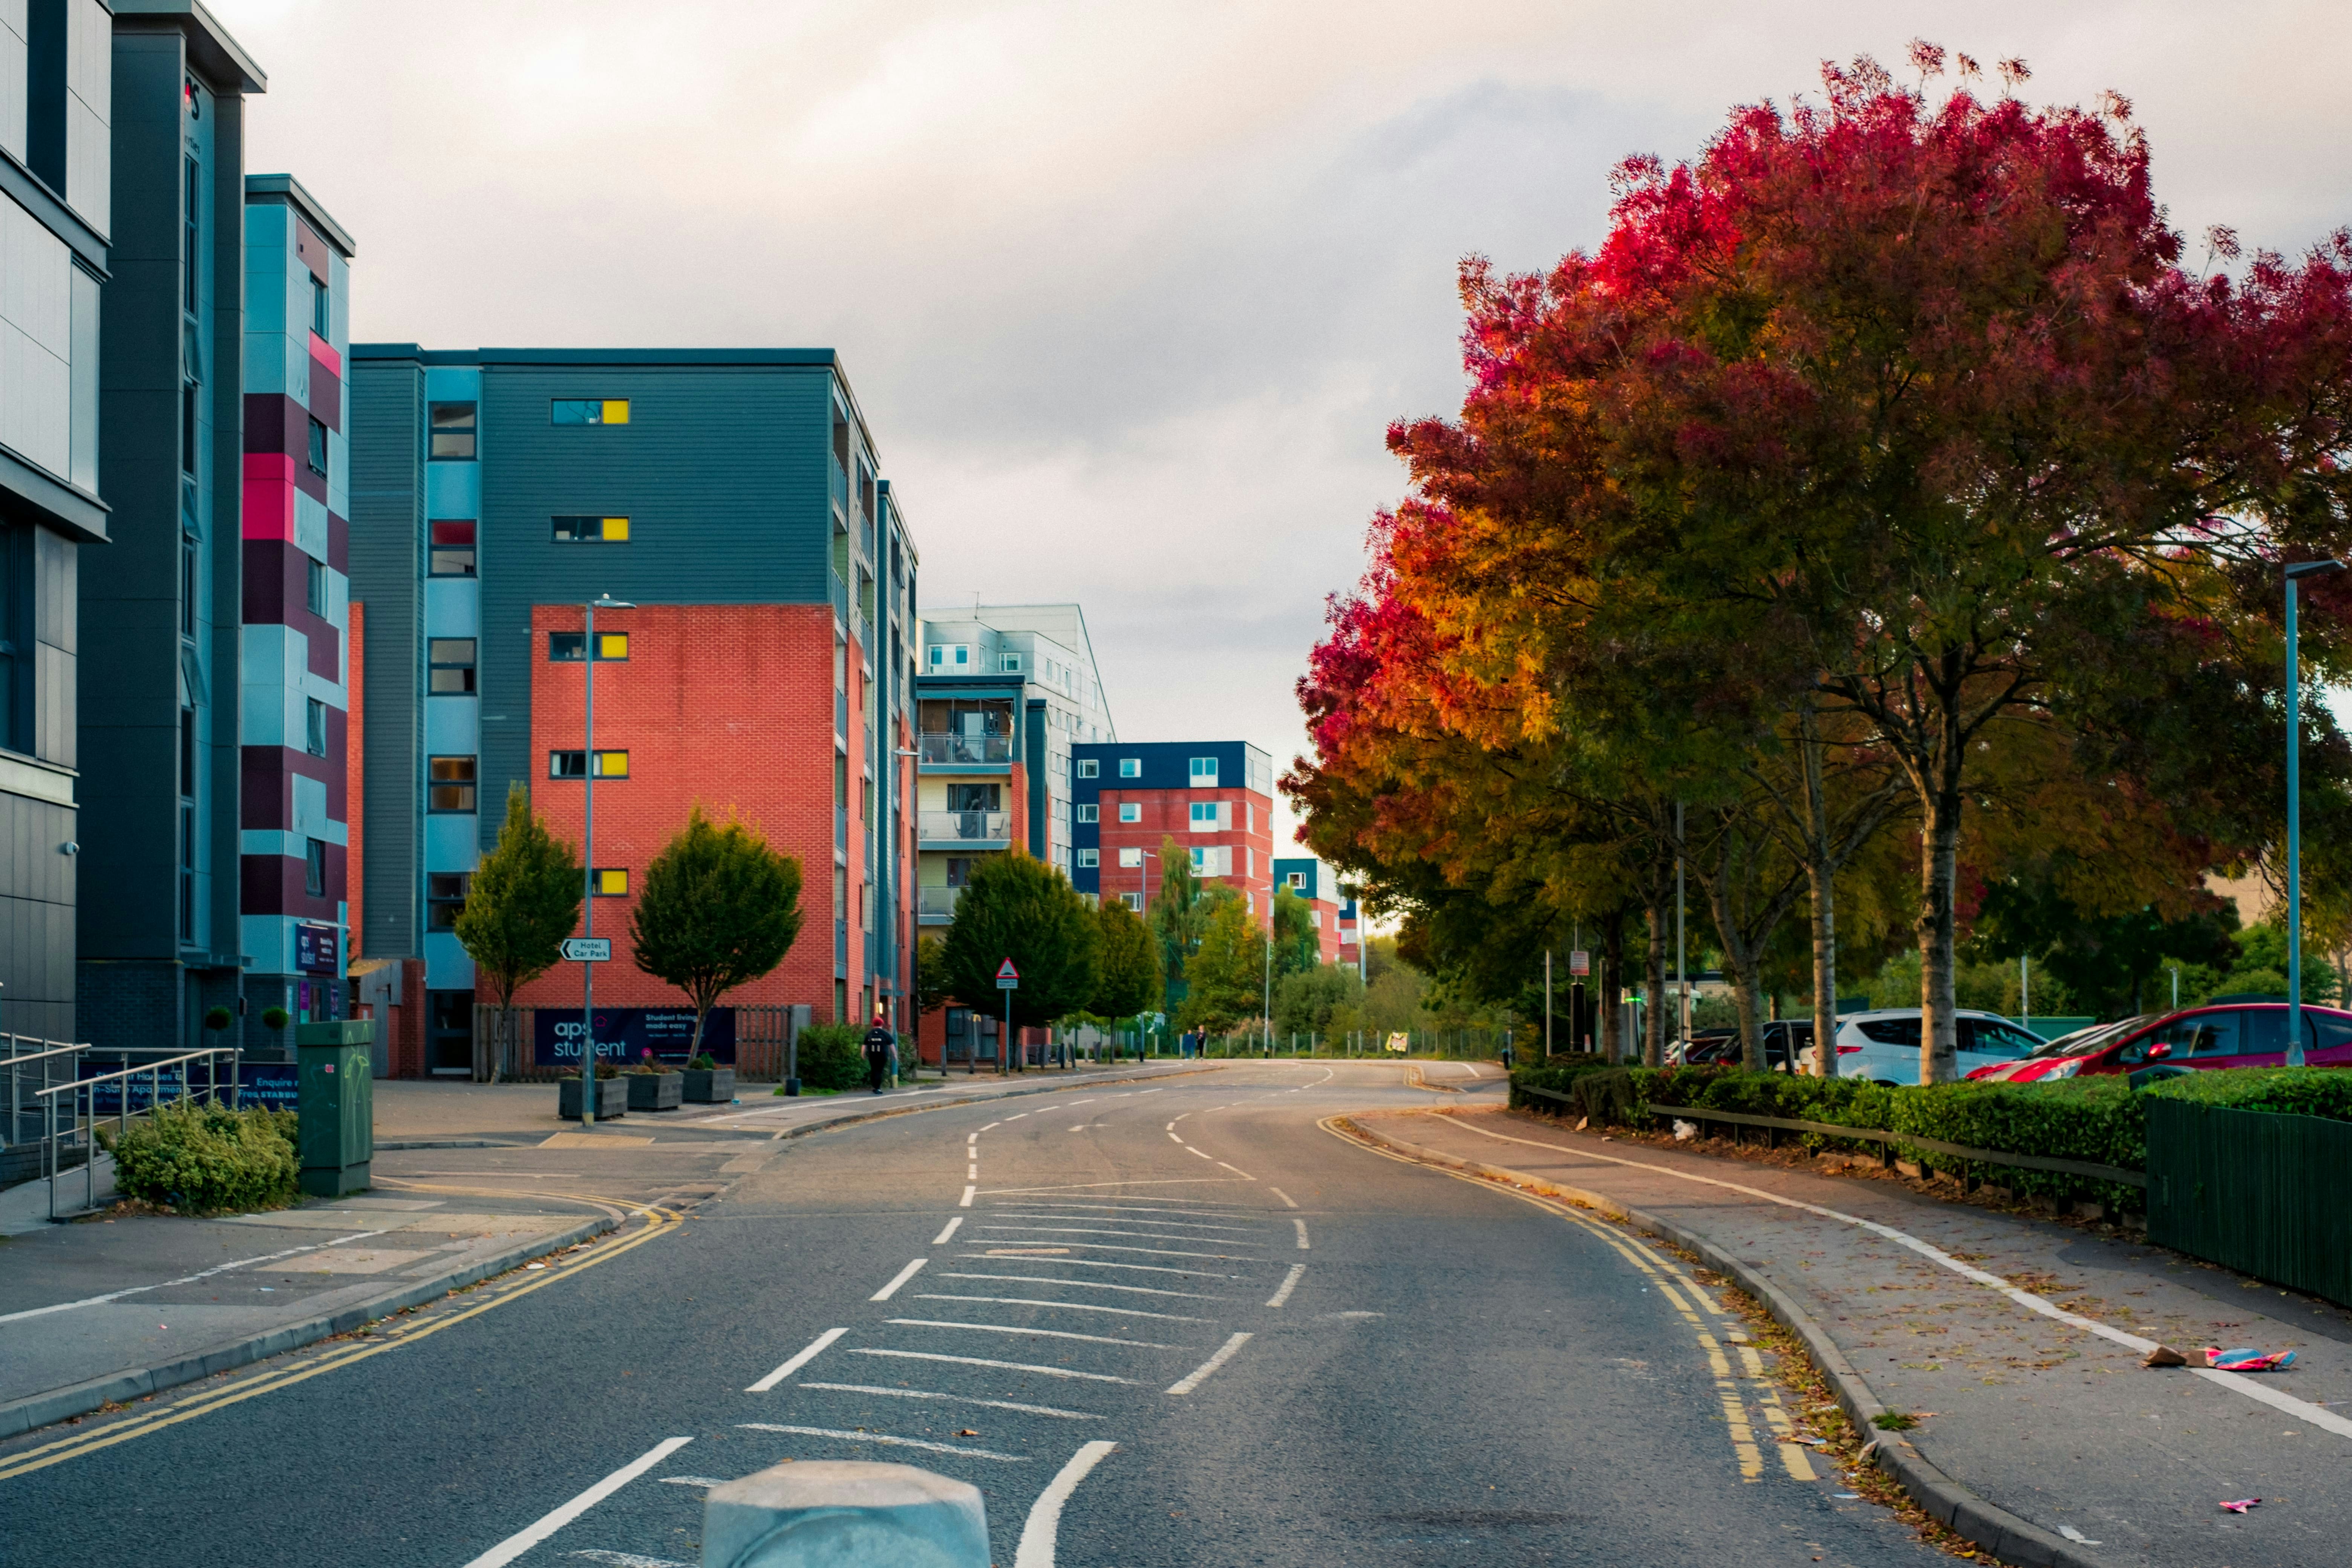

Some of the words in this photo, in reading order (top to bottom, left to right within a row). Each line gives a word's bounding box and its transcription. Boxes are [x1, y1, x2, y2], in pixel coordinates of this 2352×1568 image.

[677, 1014, 697, 1023] living
[554, 1038, 626, 1056] stuent
[257, 1078, 293, 1088] Enquire
[238, 1089, 259, 1098] Free
